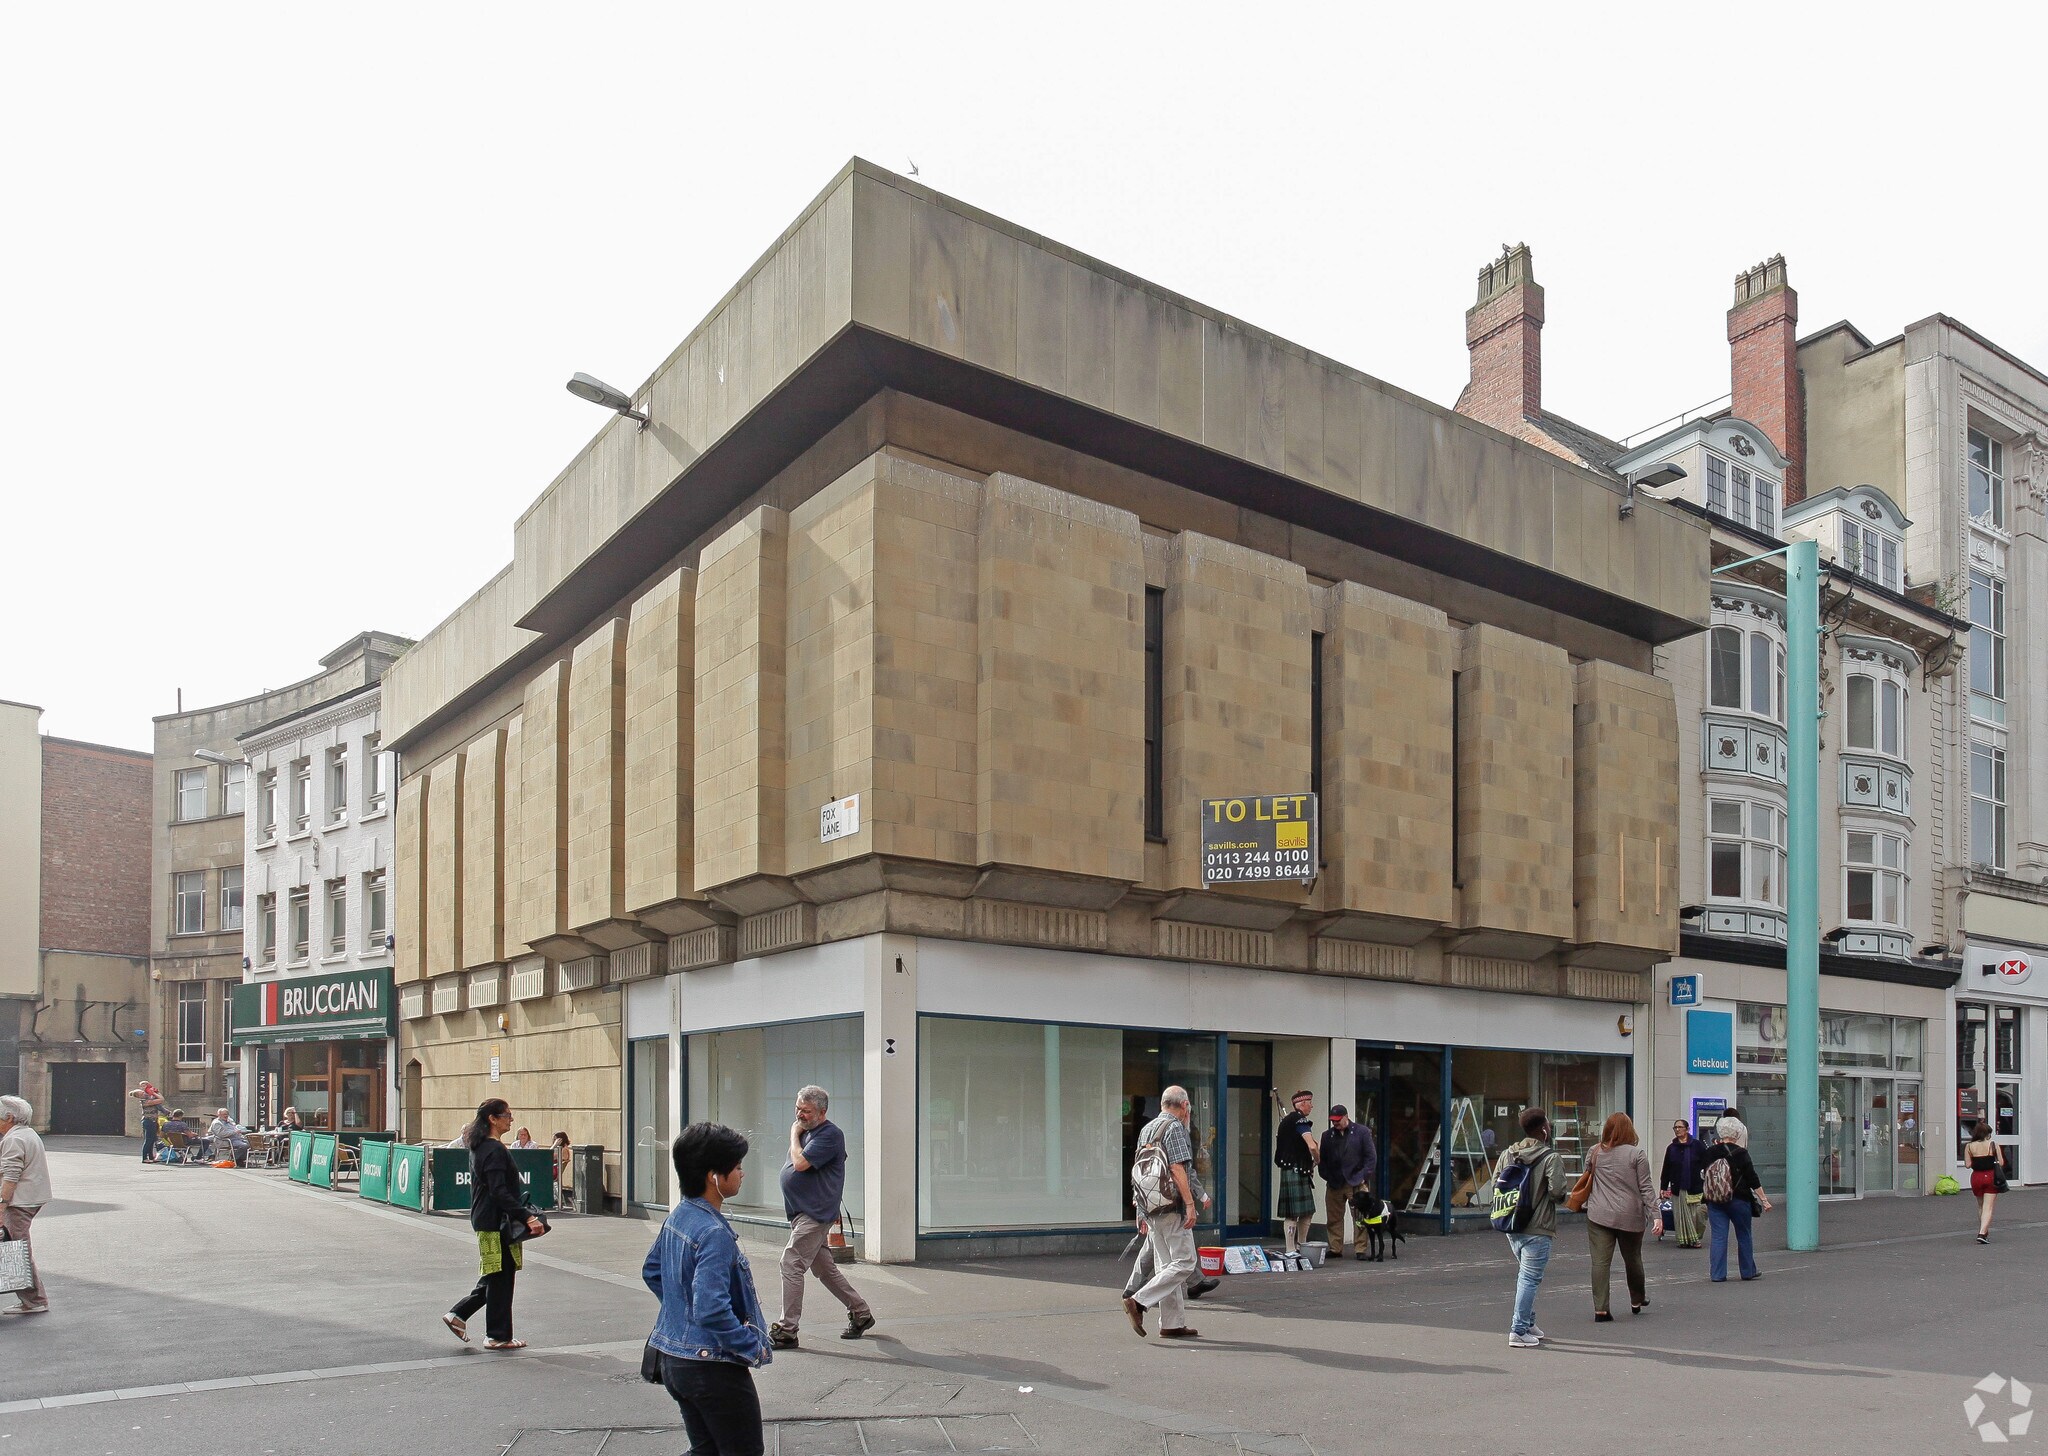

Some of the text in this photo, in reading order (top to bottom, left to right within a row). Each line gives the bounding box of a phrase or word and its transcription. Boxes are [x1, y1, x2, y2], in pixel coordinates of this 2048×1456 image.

[822, 808, 836, 822] FOX
[1209, 796, 1307, 823] TO LET
[822, 821, 840, 837] LANE
[1208, 841, 1258, 850] savills.com
[1277, 837, 1306, 848] savills
[1207, 849, 1309, 865] 0113 244 0100
[1207, 864, 1310, 880] 020 7499 8644
[283, 979, 378, 1017] BRUCCIANI
[1692, 1058, 1729, 1069] checkout
[1490, 1193, 1518, 1213] NIKE
